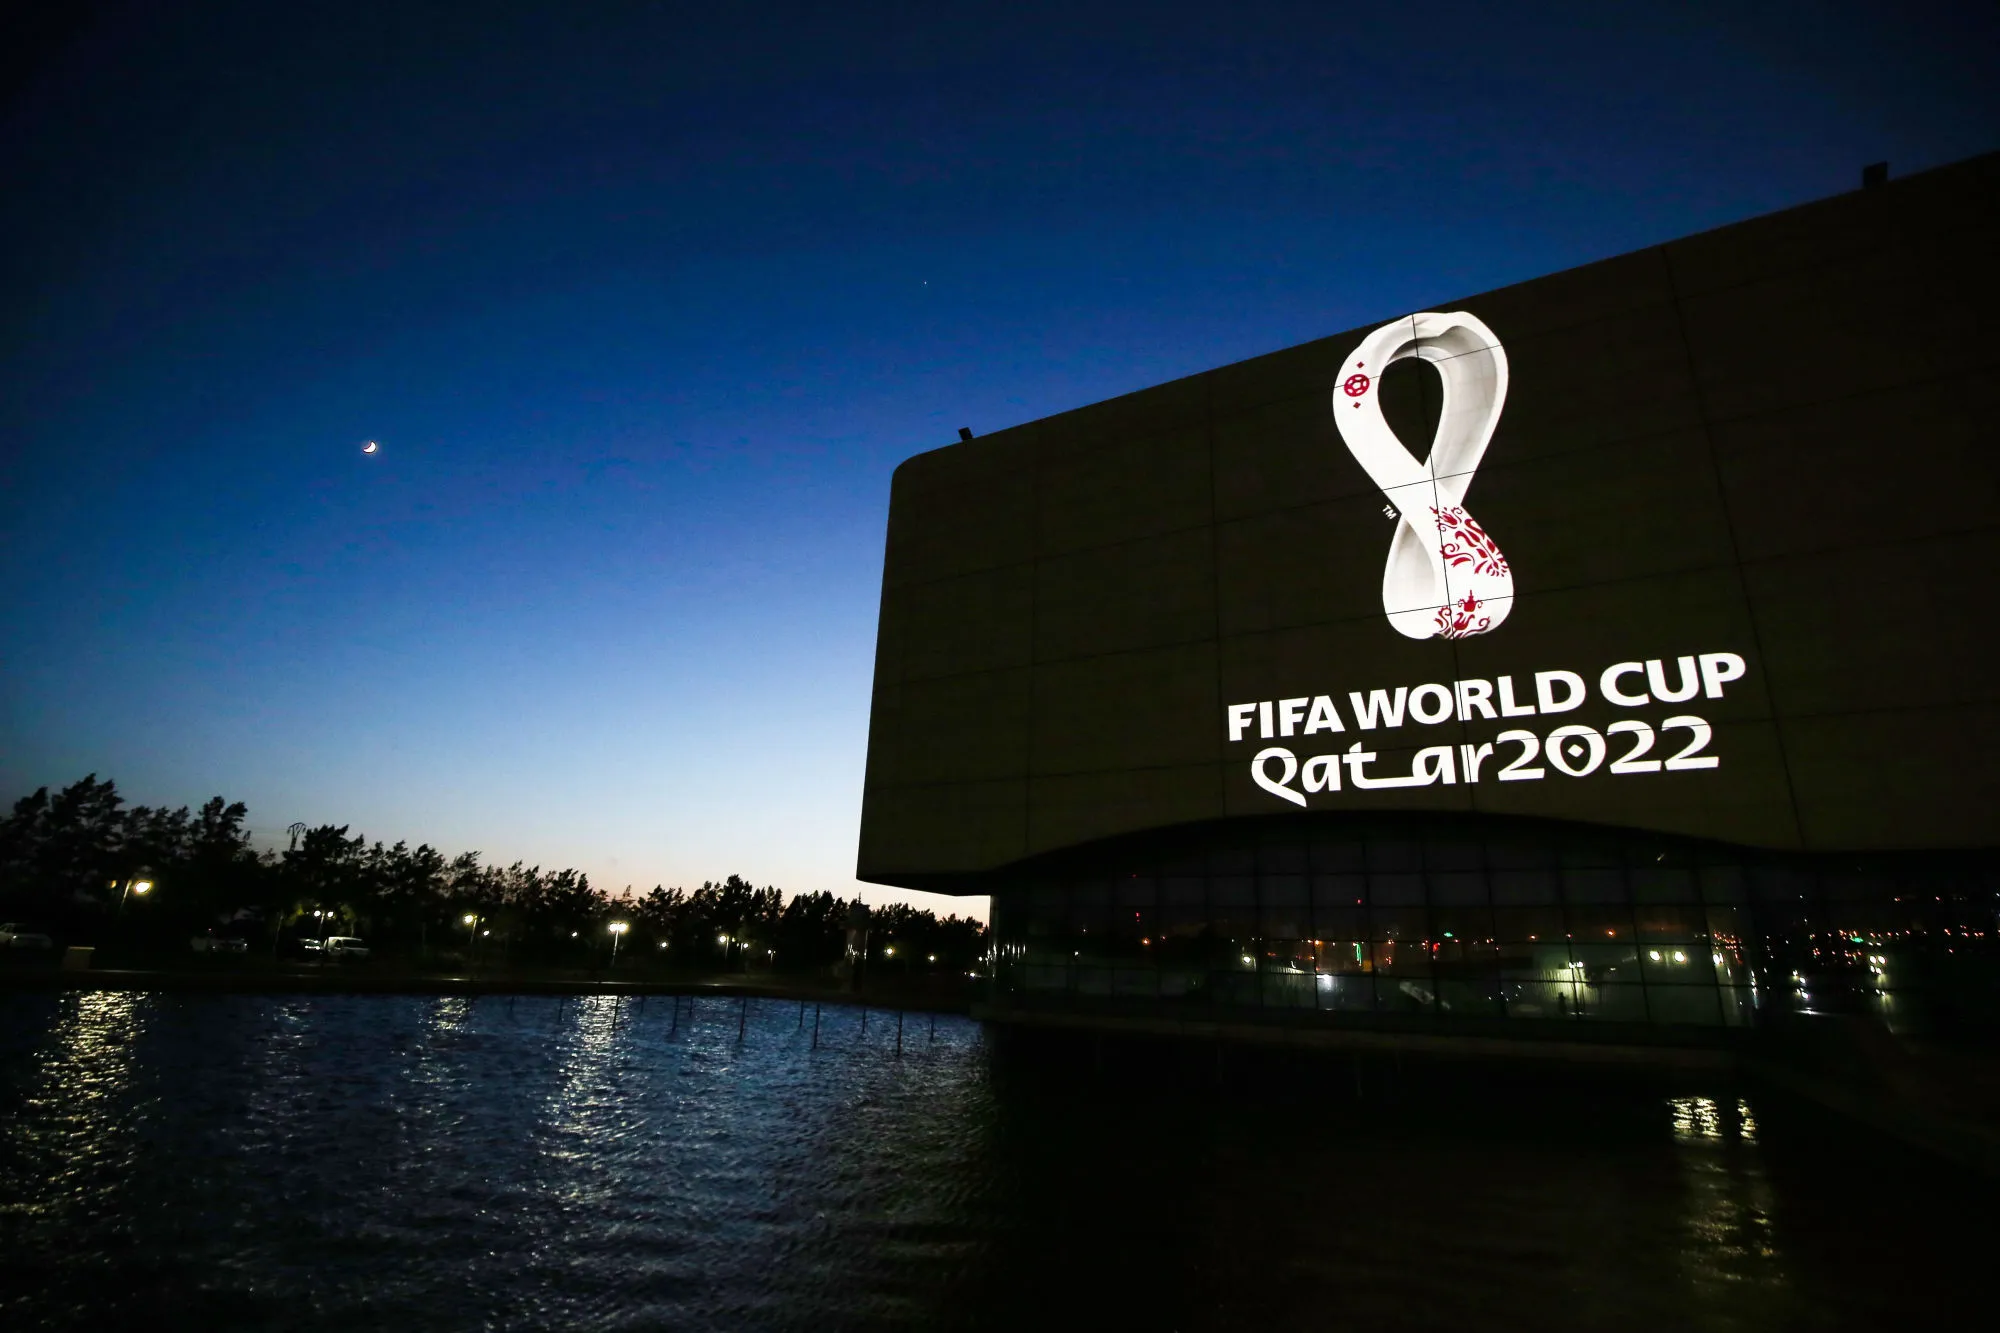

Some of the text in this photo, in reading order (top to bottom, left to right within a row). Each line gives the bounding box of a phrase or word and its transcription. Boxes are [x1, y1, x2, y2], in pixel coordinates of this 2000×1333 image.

[1228, 652, 1746, 742] FIFA WORLD CUP
